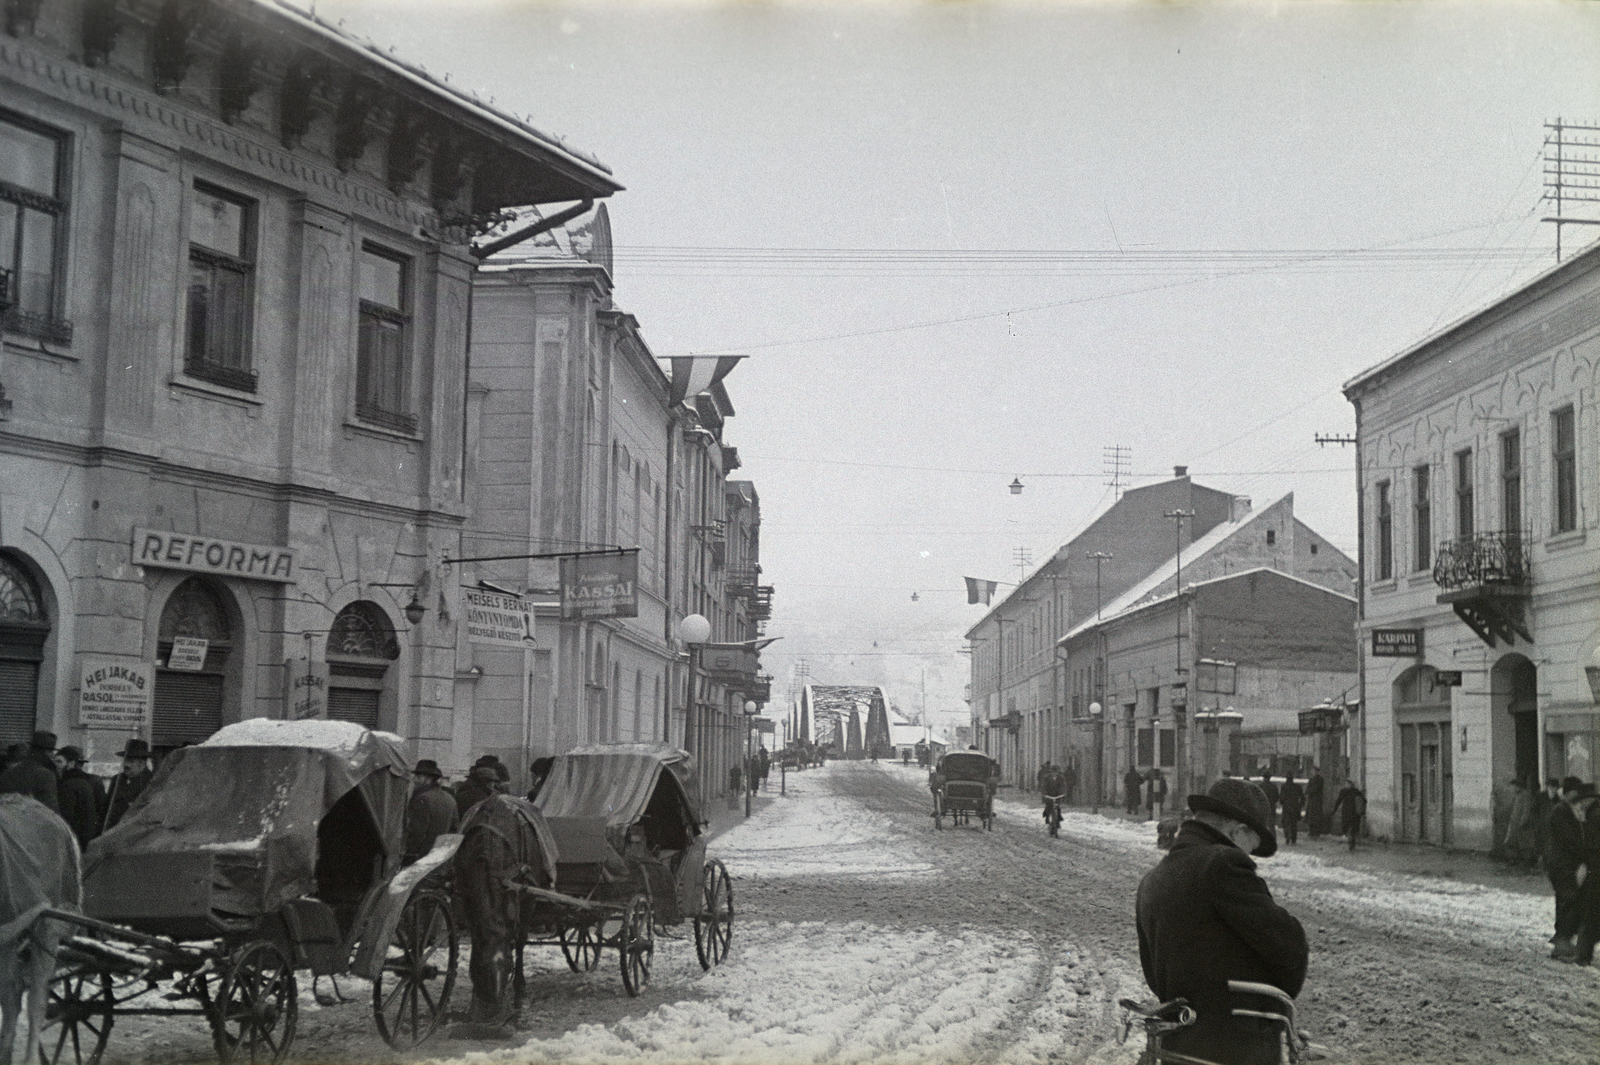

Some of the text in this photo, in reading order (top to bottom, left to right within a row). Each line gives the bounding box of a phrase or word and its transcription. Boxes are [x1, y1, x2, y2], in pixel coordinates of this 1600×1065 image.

[141, 532, 292, 577] REFORMA
[467, 592, 500, 608] MEISELS
[564, 580, 632, 600] KASSAI
[85, 666, 146, 690] HEI JAKAB
[82, 692, 115, 704] RASOL
